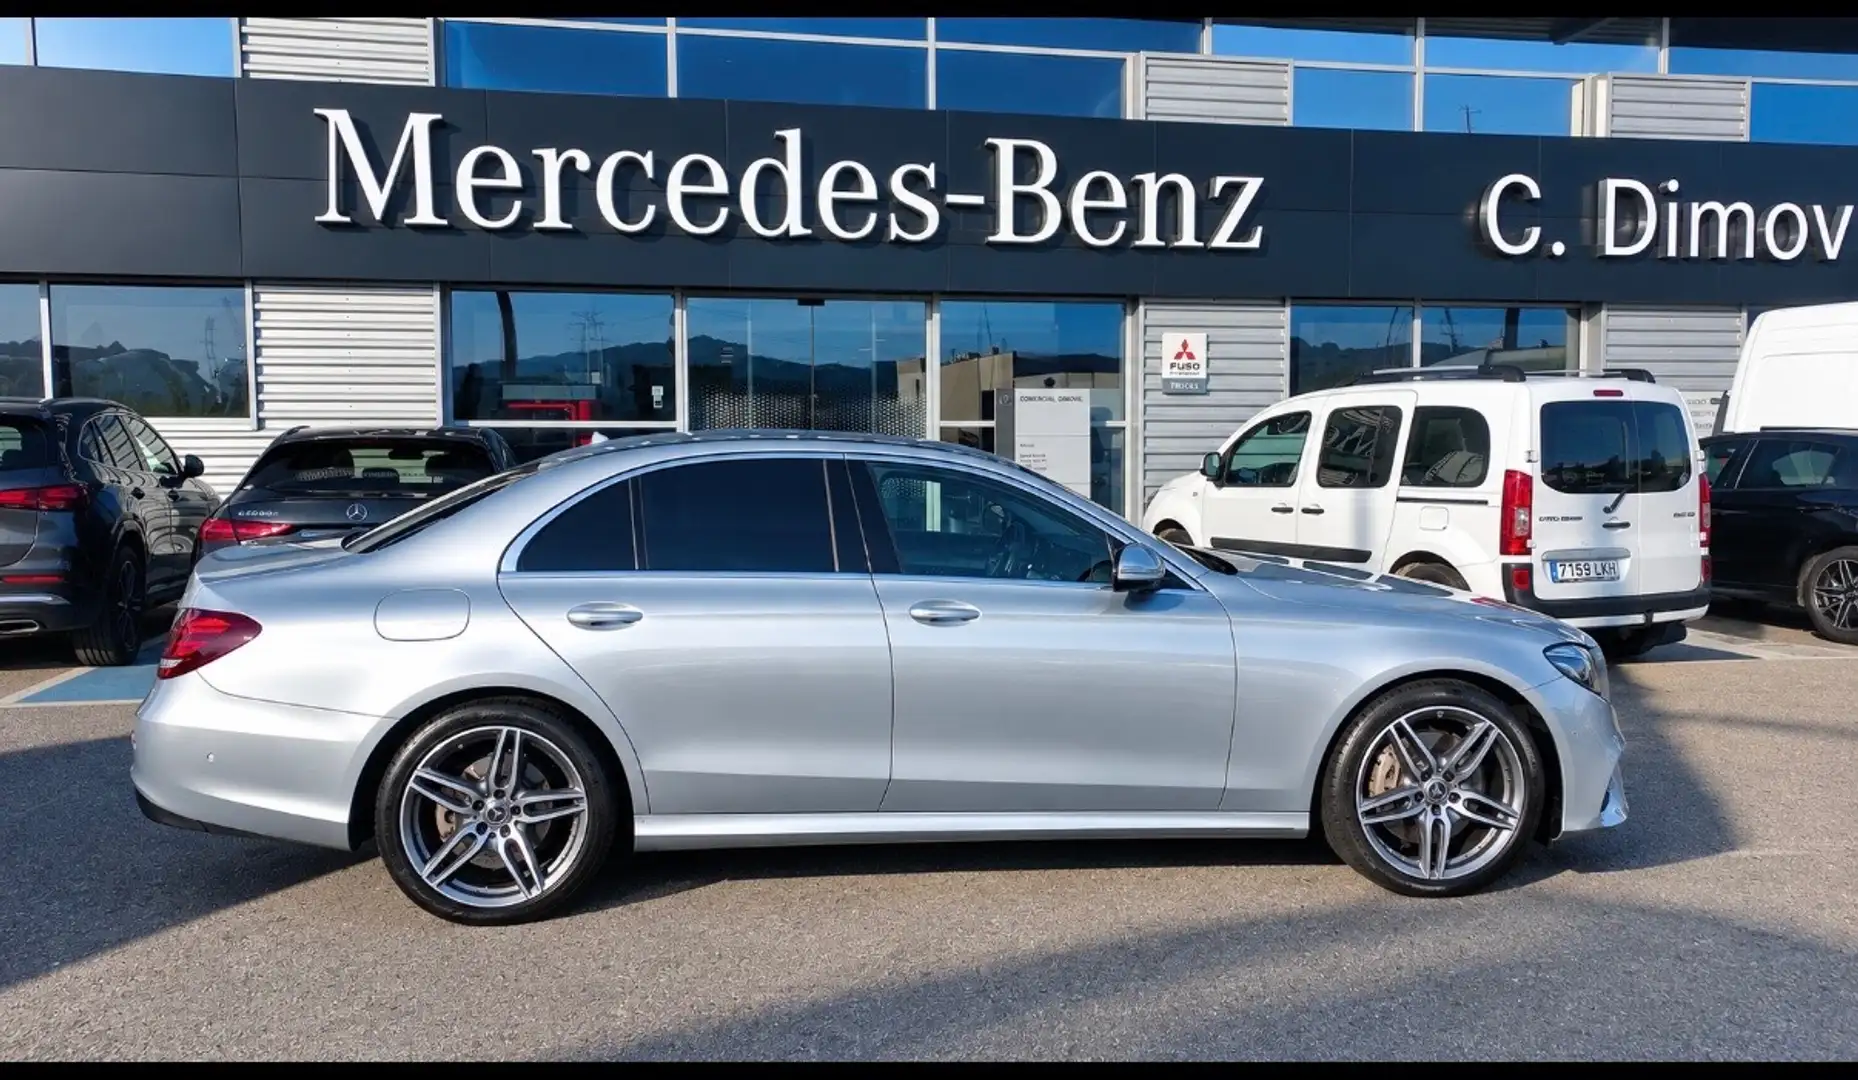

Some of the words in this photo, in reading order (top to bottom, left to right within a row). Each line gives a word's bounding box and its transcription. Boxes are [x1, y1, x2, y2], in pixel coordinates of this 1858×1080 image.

[313, 107, 1265, 250] Mercedes-Benz
[1481, 173, 1566, 256] C.
[1598, 177, 1856, 261] Dimov
[1169, 362, 1201, 371] FUSO
[1559, 562, 1592, 578] 7159
[1594, 561, 1617, 576] LKH
